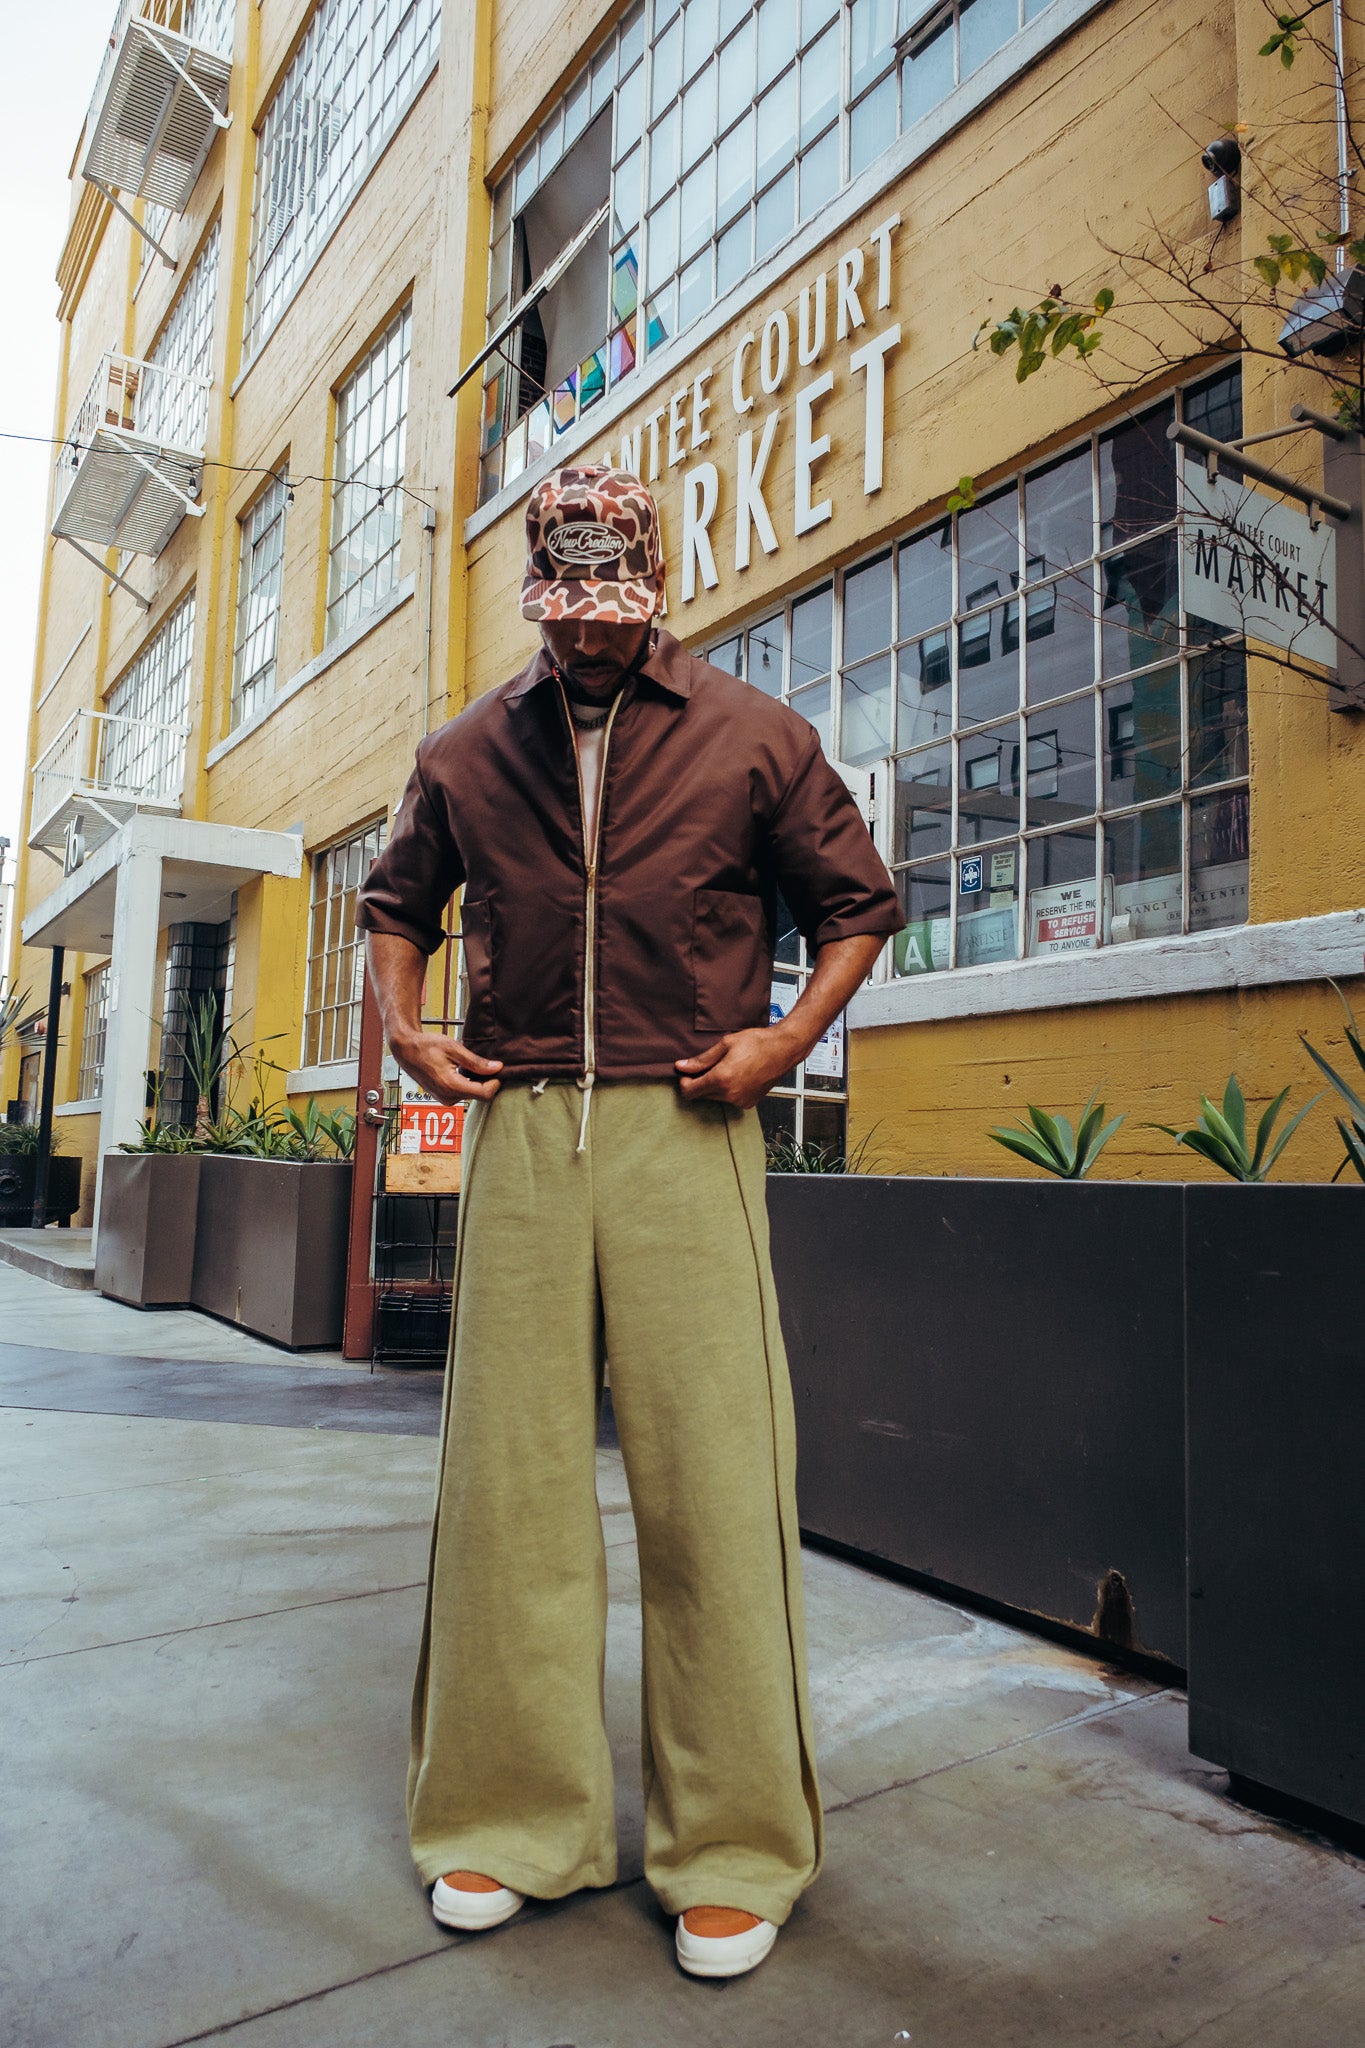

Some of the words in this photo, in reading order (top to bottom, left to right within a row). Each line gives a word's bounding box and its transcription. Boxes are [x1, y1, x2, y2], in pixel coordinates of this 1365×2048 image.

[602, 366, 713, 482] NTEE
[731, 212, 902, 414] COURT
[657, 323, 902, 618] RKET
[551, 526, 578, 550] New
[572, 525, 624, 550] Creation
[1238, 520, 1265, 547] NTEE
[1268, 534, 1301, 563] COURT
[1195, 528, 1328, 626] MARKET
[1036, 904, 1067, 918] RESERVE
[1070, 901, 1083, 912] THE
[1085, 897, 1107, 909] RIGT
[1060, 889, 1082, 901] WE
[1048, 919, 1058, 929] TO
[1061, 913, 1095, 927] REFUSE
[1054, 925, 1087, 939] SERVICE
[964, 928, 1009, 949] ARTISTE
[1049, 942, 1059, 952] TO
[1061, 938, 1091, 950] ANYONE
[904, 935, 927, 971] A
[409, 1111, 455, 1147] 102
